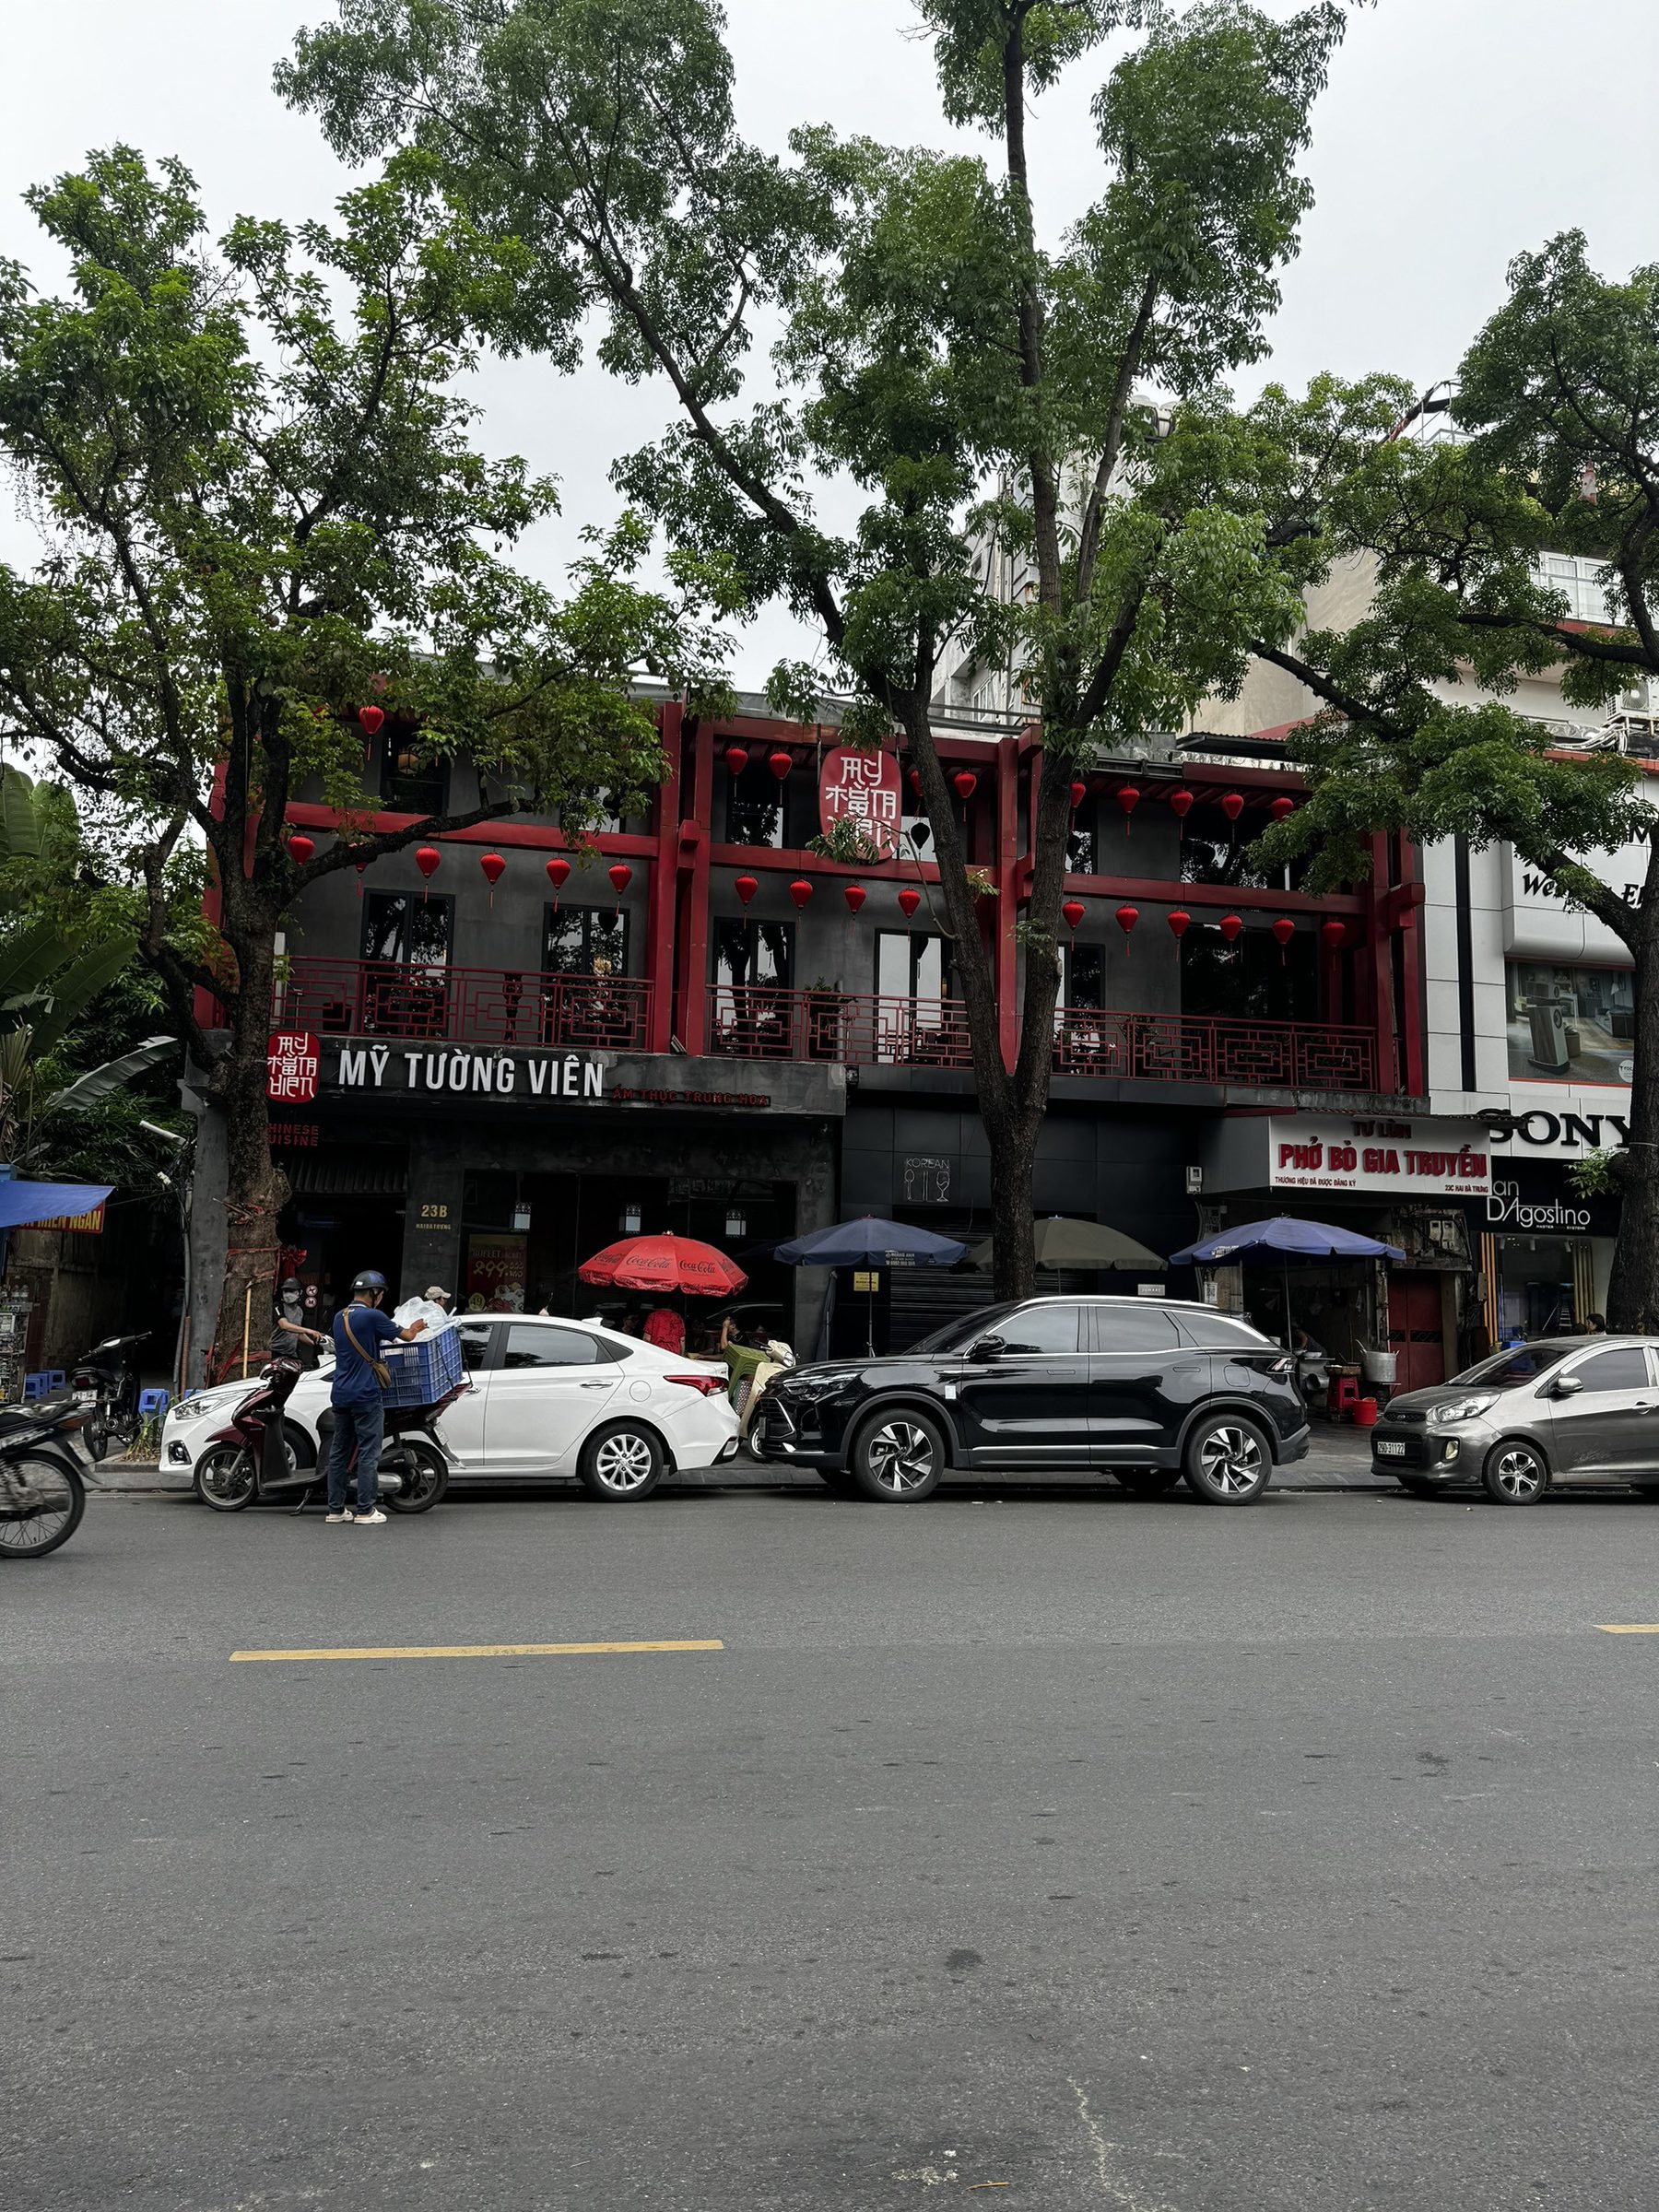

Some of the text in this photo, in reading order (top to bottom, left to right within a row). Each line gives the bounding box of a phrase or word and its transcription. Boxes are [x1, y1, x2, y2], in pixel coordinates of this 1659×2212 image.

[338, 1044, 604, 1098] MỸ TƯỜNG VIÊN
[684, 1090, 731, 1104] TRUNG
[736, 1094, 769, 1107] HOA
[267, 1123, 319, 1135] HINESE
[266, 1135, 319, 1147] UISINE
[1278, 1135, 1324, 1171] PHỞ
[1328, 1139, 1357, 1171] BÒ
[1362, 1147, 1400, 1174] GIA
[906, 1157, 950, 1169] KOREAN
[1492, 1180, 1519, 1196] an
[420, 1205, 448, 1218] 23B
